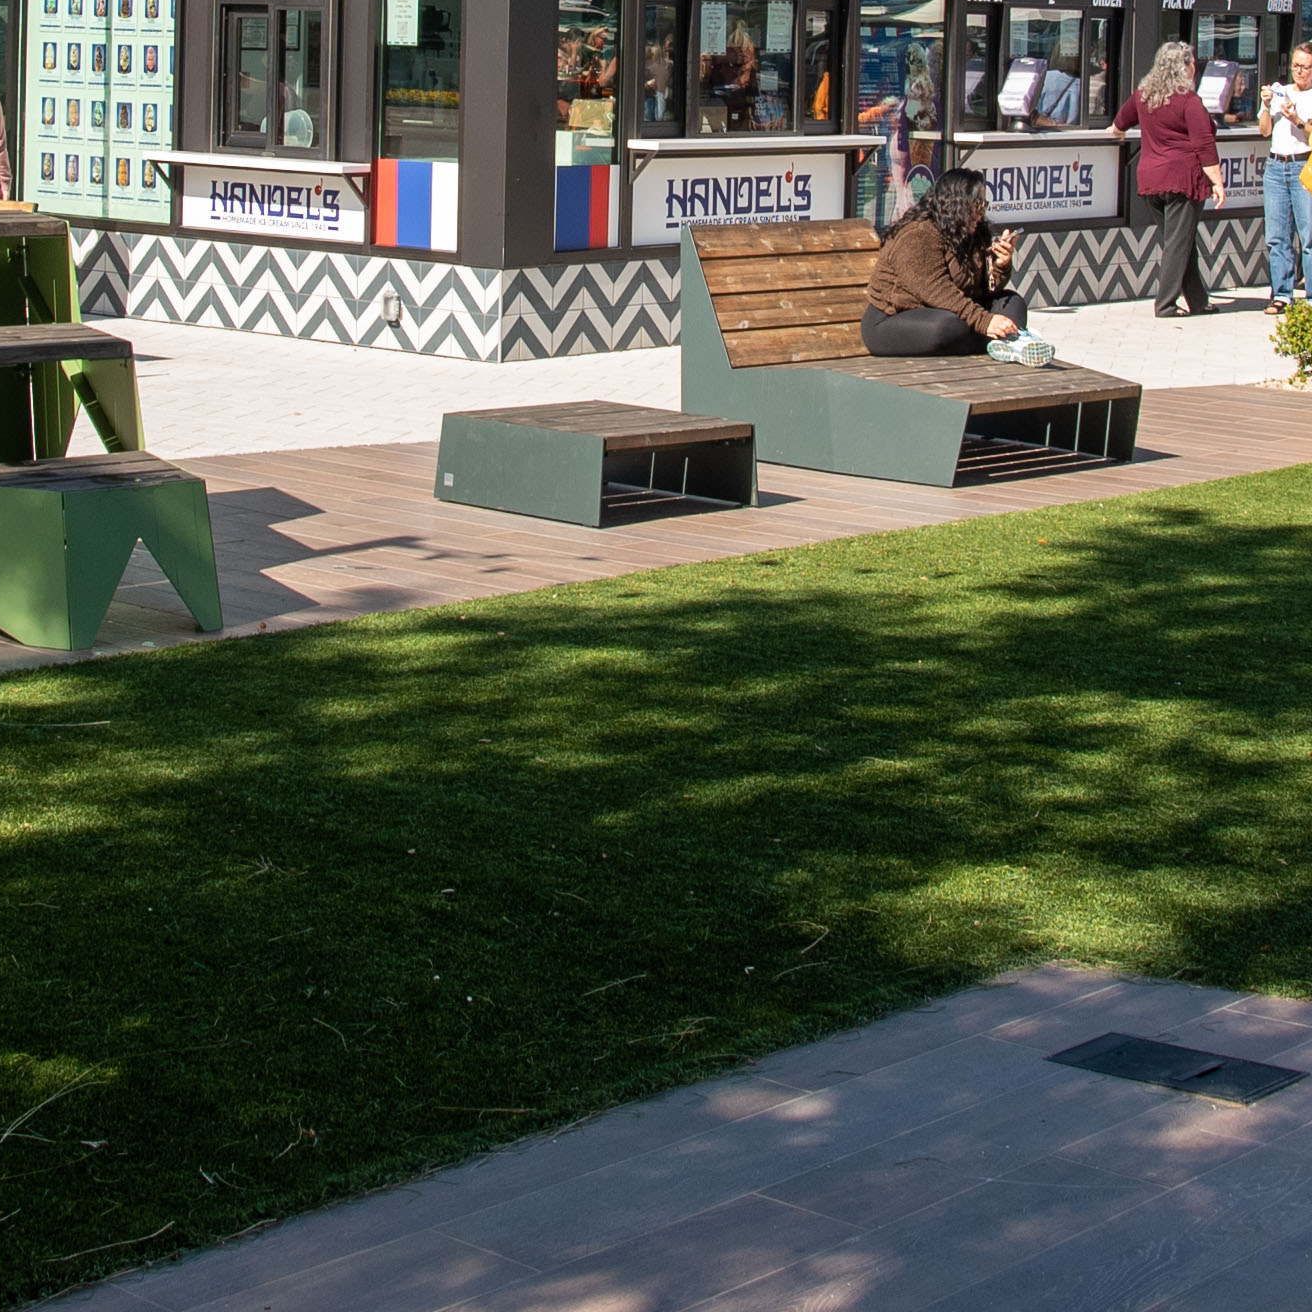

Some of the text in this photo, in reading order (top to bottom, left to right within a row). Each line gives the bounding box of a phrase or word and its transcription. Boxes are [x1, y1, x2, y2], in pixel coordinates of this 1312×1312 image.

[665, 162, 812, 218] HANDEL'S
[982, 153, 1094, 202] HANDEL'S
[210, 177, 340, 222] HANDEL'S
[992, 200, 1082, 212] HOMEMADE ICE CREAM SINCE 1945
[222, 215, 256, 225] HOMEMADE
[258, 218, 267, 226] ICE
[269, 219, 290, 228] CREAM
[290, 221, 309, 230] SINCE
[759, 215, 779, 224] SINCE
[782, 214, 797, 223] 1945
